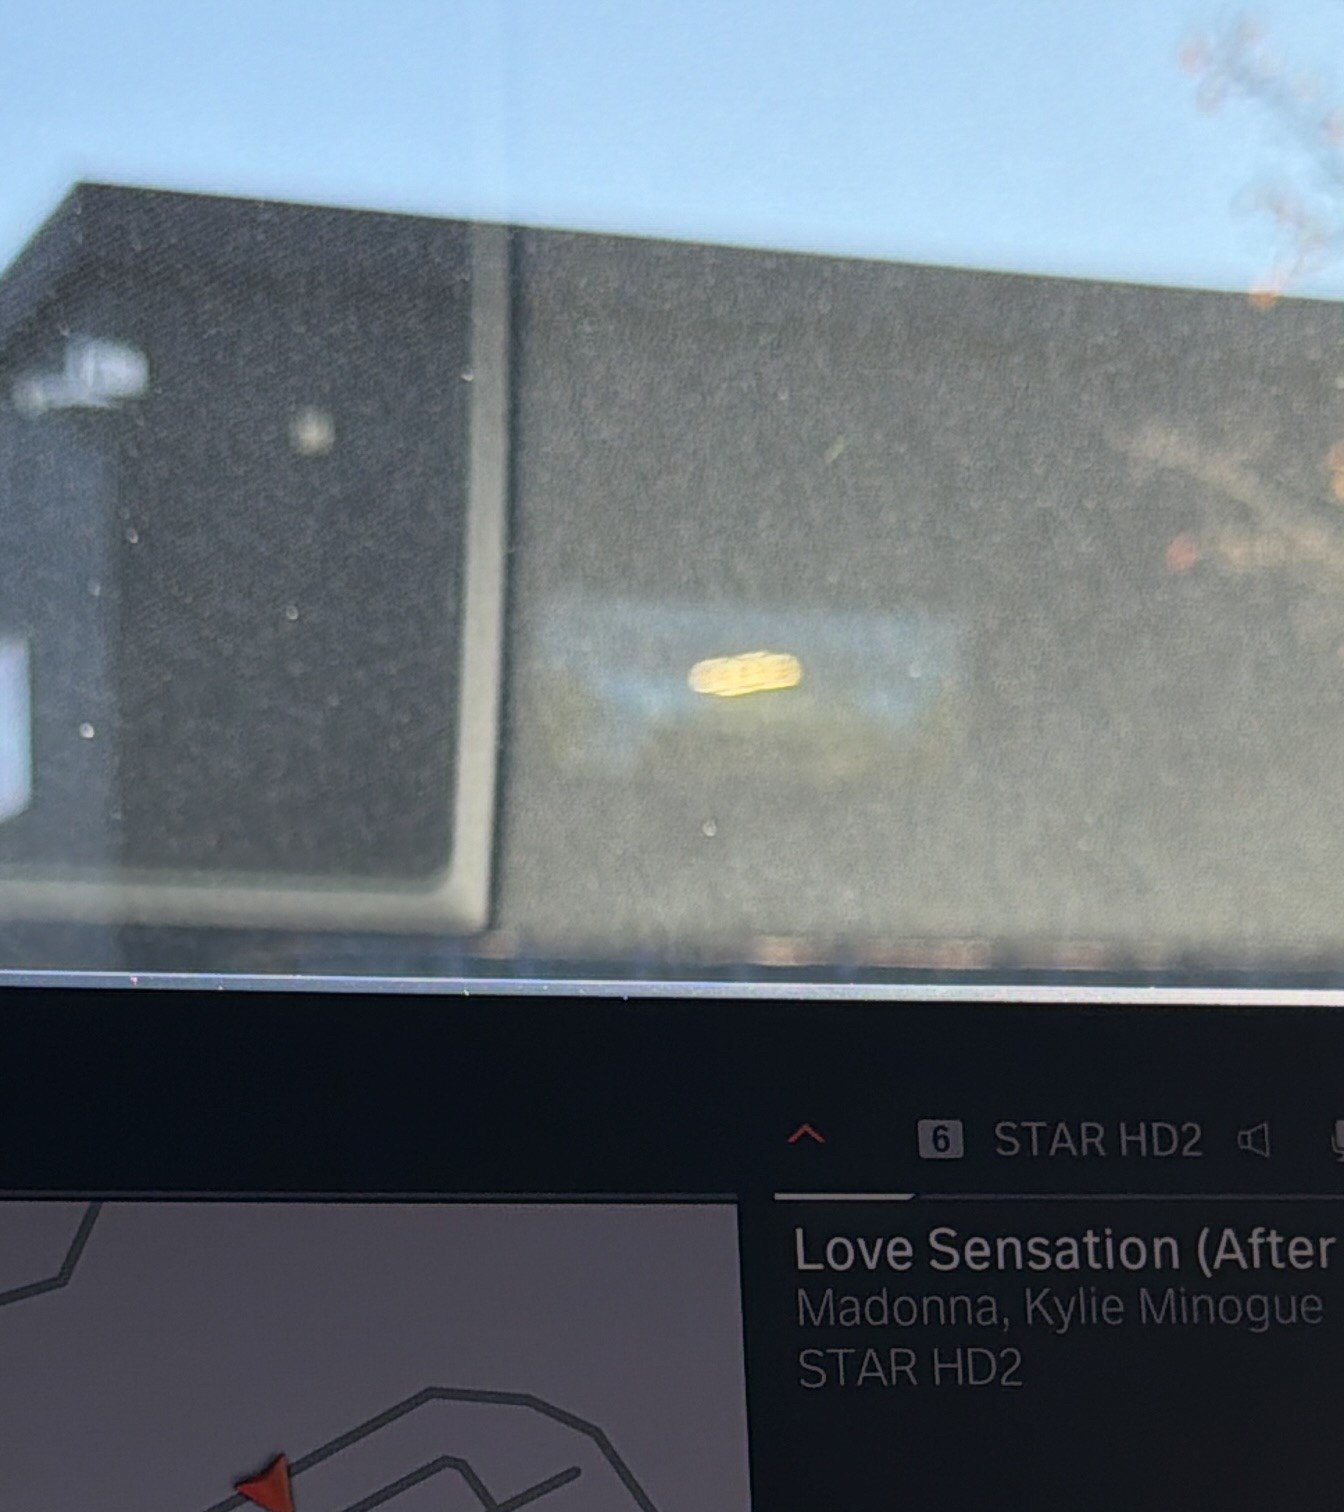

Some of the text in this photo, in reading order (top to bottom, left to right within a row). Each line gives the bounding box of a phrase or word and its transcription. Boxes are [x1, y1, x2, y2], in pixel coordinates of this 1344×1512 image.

[932, 1125, 950, 1152] 6
[995, 1122, 1202, 1156] STAR HD2
[796, 1228, 912, 1270] Love
[929, 1228, 1179, 1270] Sensation
[1198, 1227, 1336, 1277] (After
[798, 1287, 1322, 1333] Madonna, Kylie Minogue
[799, 1348, 1022, 1388] STAR HD2
